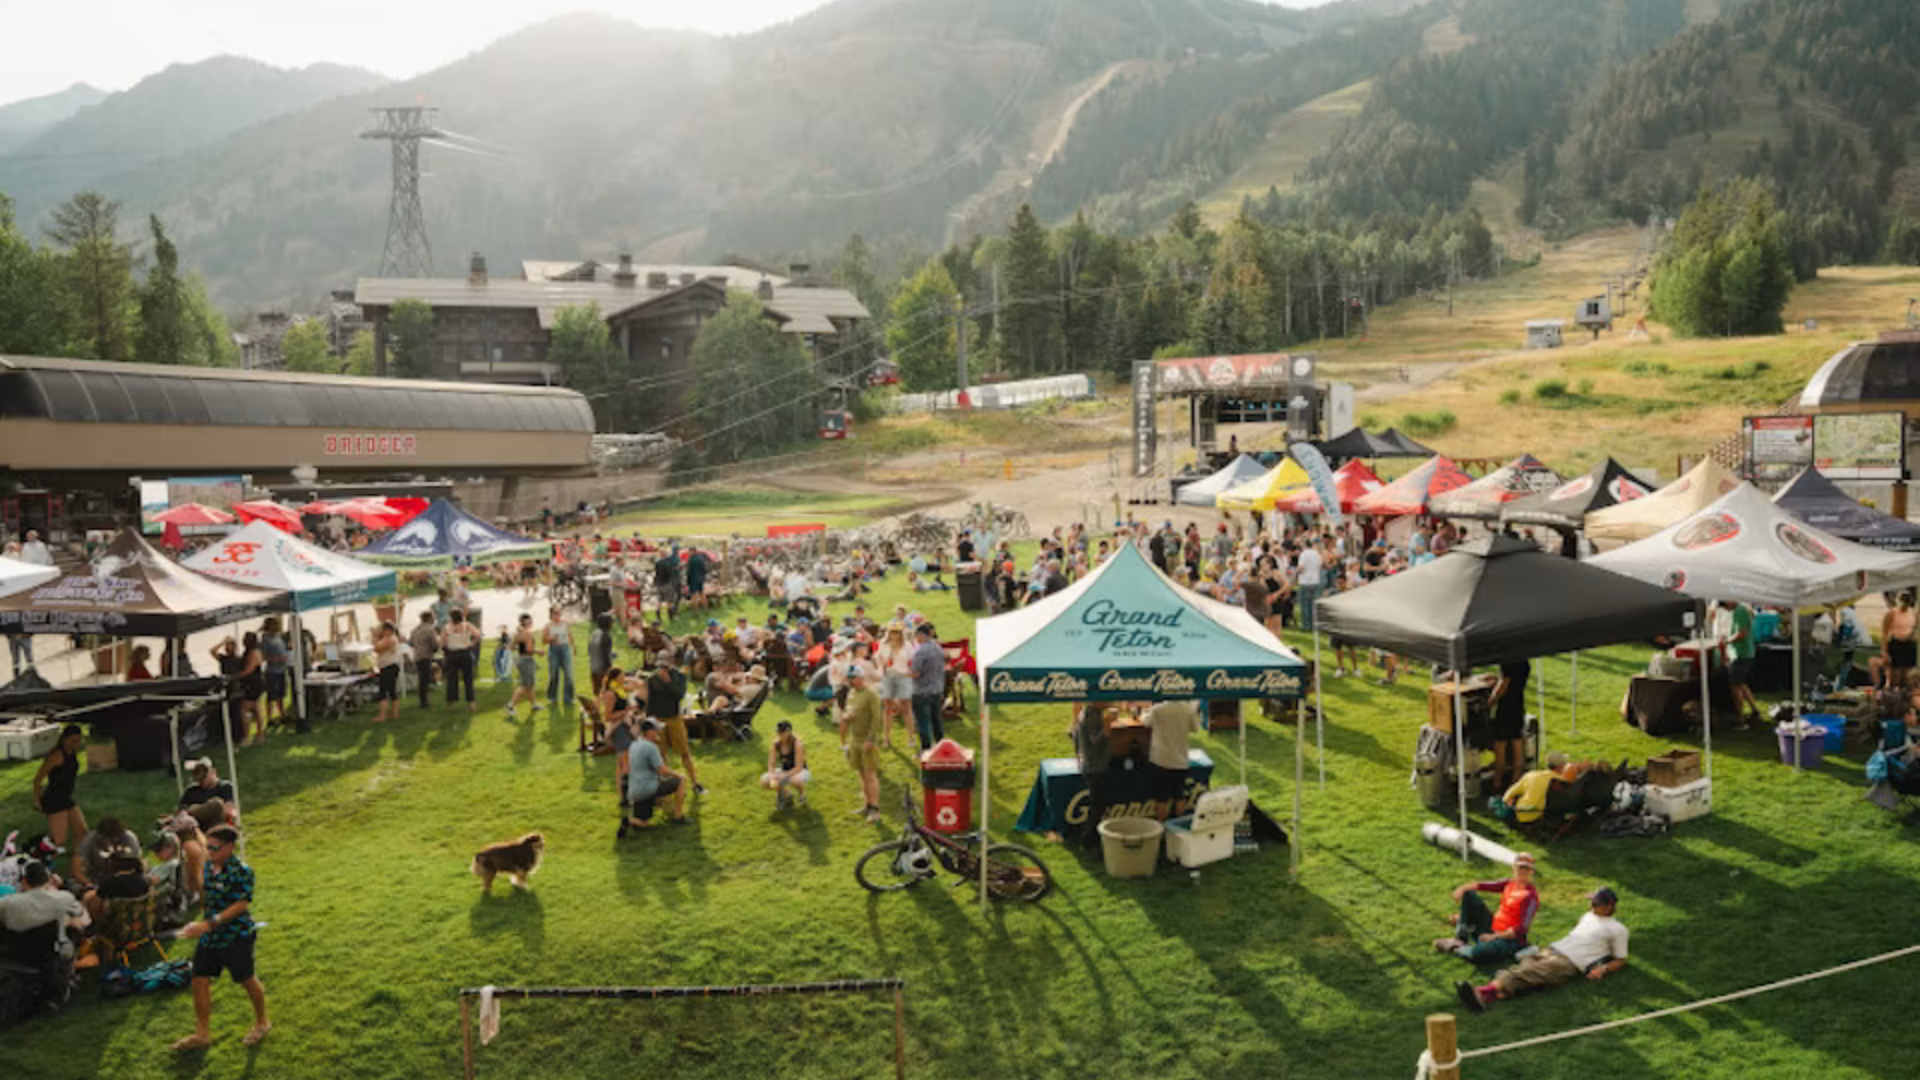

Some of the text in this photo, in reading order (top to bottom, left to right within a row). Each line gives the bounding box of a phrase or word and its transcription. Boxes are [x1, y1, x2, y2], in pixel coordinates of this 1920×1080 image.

[323, 433, 417, 455] BRIDGER
[1082, 599, 1185, 627] Grand
[1091, 627, 1176, 652] Teton
[990, 671, 1089, 695] Grand Teton
[1098, 669, 1196, 693] Grand Teton
[1206, 669, 1302, 693] Grand Teton
